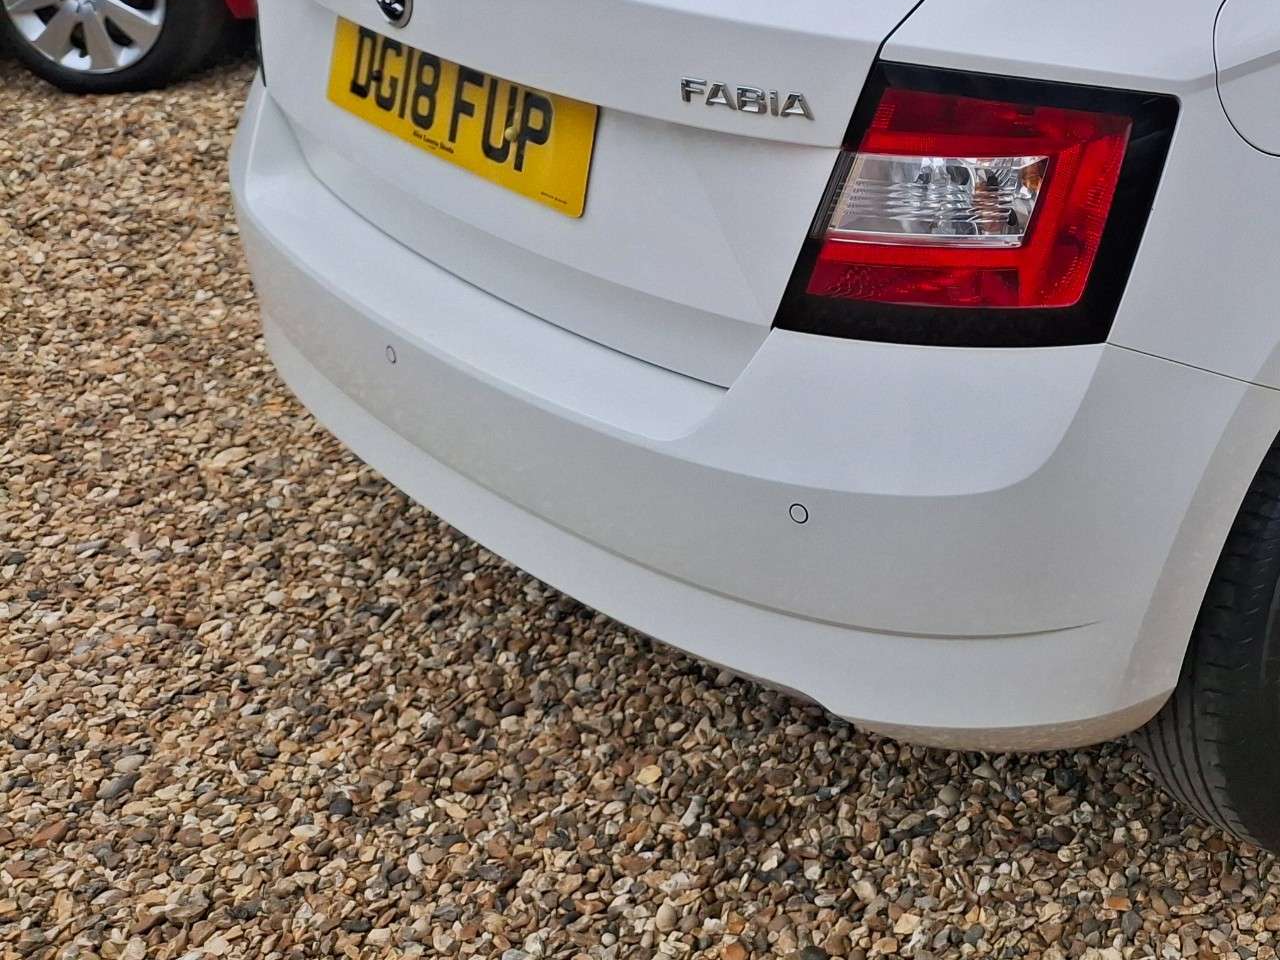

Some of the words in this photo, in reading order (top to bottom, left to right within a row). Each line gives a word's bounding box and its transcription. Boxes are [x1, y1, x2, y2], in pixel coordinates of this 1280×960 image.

[350, 25, 442, 131] DG18
[448, 64, 554, 173] FUP
[680, 75, 816, 122] FABIA
